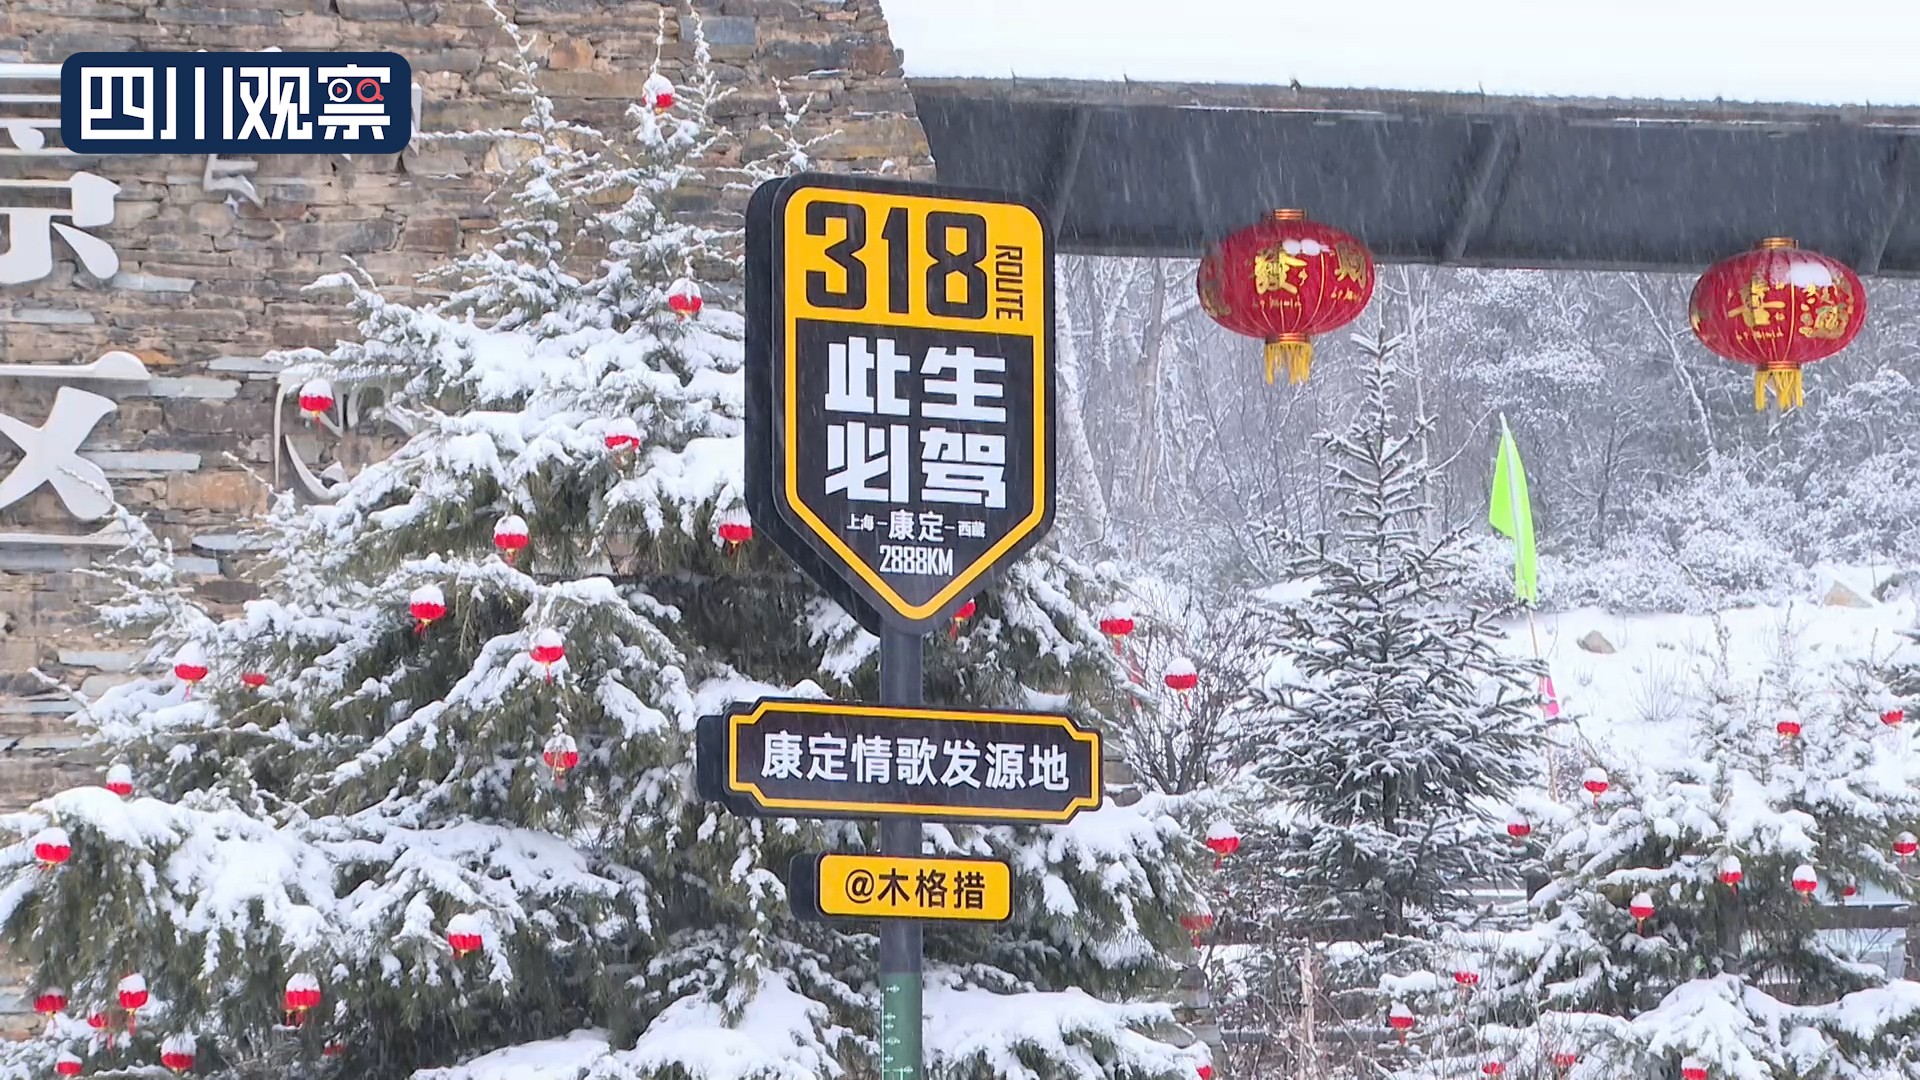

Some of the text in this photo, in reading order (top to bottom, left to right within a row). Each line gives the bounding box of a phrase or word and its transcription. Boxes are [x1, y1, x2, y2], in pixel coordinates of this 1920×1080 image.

[805, 200, 987, 320] 318
[995, 244, 1023, 321] ROUTE
[824, 336, 1006, 422] 此生
[824, 421, 1006, 509] 必驾
[879, 544, 954, 576] 2888KM
[760, 729, 1071, 792] 康定情歌发源地
[845, 867, 986, 910] @木格措
